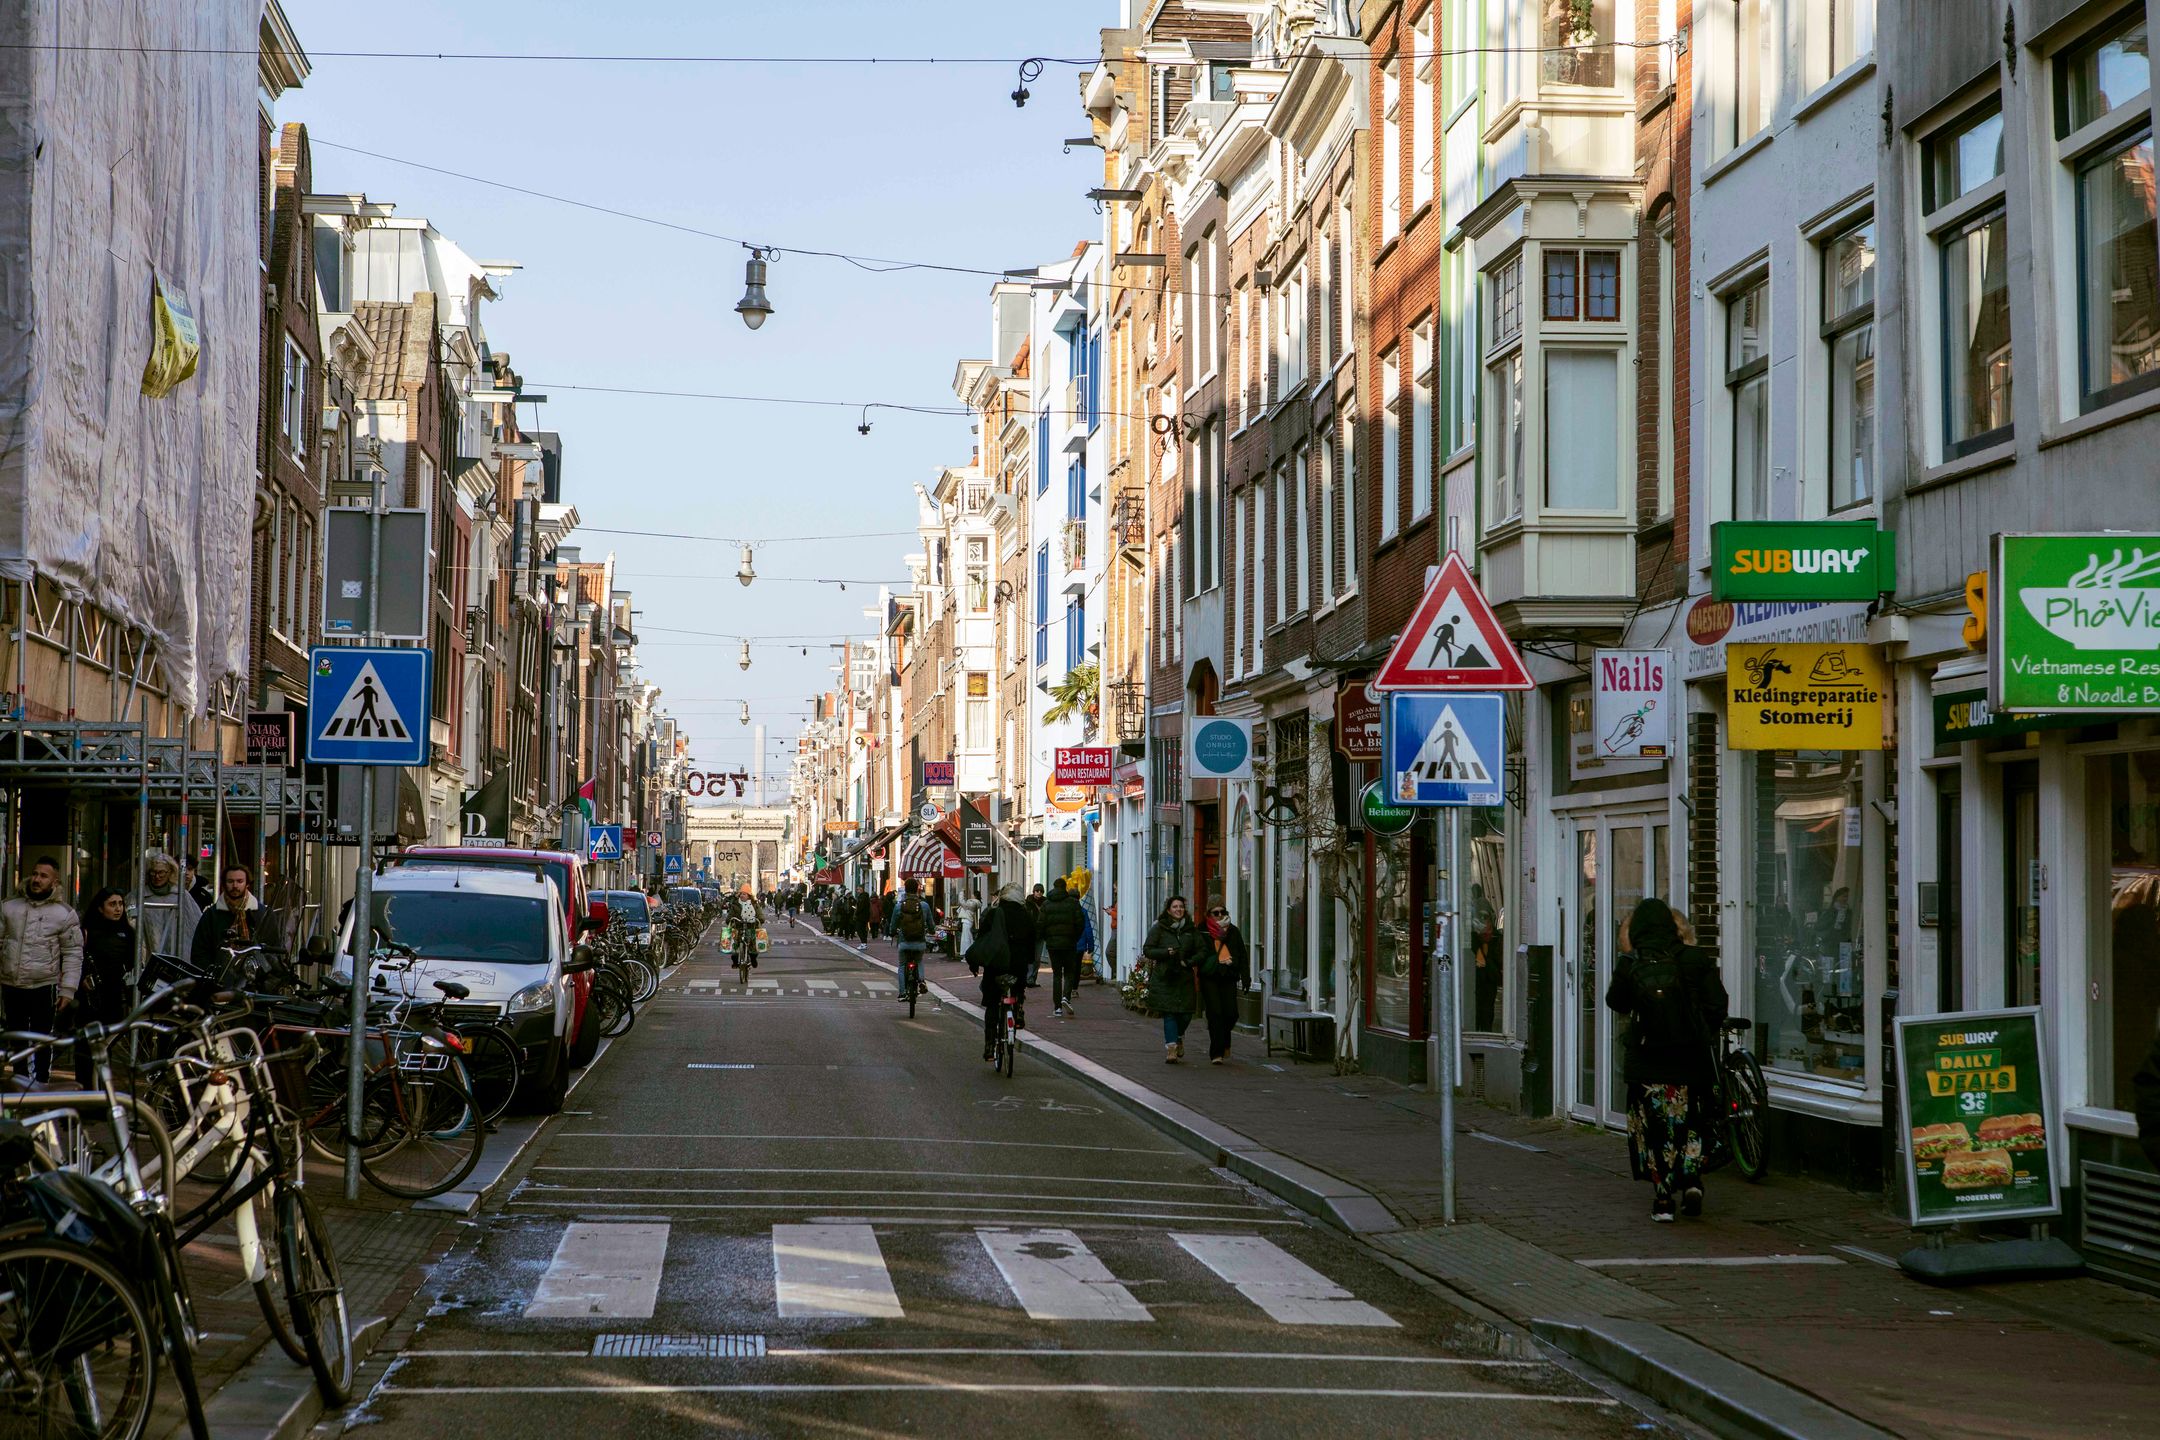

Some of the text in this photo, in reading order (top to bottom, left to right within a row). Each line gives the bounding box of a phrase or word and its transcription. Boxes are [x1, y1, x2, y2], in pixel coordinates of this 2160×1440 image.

[1730, 547, 1870, 575] SUBWAY
[1689, 603, 1730, 637] MAESTRO
[2011, 654, 2116, 675] Vietnamese
[1601, 656, 1663, 692] Nails
[1734, 687, 1878, 706] Kledingreparatie
[2075, 682, 2138, 703] Noodle
[2143, 686, 2160, 703] B
[1760, 707, 1853, 728] Stomerij
[1344, 725, 1362, 733] sinds
[1349, 738, 1364, 747] LA
[1057, 750, 1110, 767] Balraj
[1057, 768, 1110, 779] INDIAN RESTAURANT
[1368, 807, 1411, 817] Heineken
[464, 840, 503, 848] TATTOO
[1938, 1031, 1999, 1047] SUBWAY
[1940, 1054, 1993, 1070] DAILY
[1938, 1072, 2011, 1093] DEALS
[1955, 1194, 1989, 1202] PROBEER
